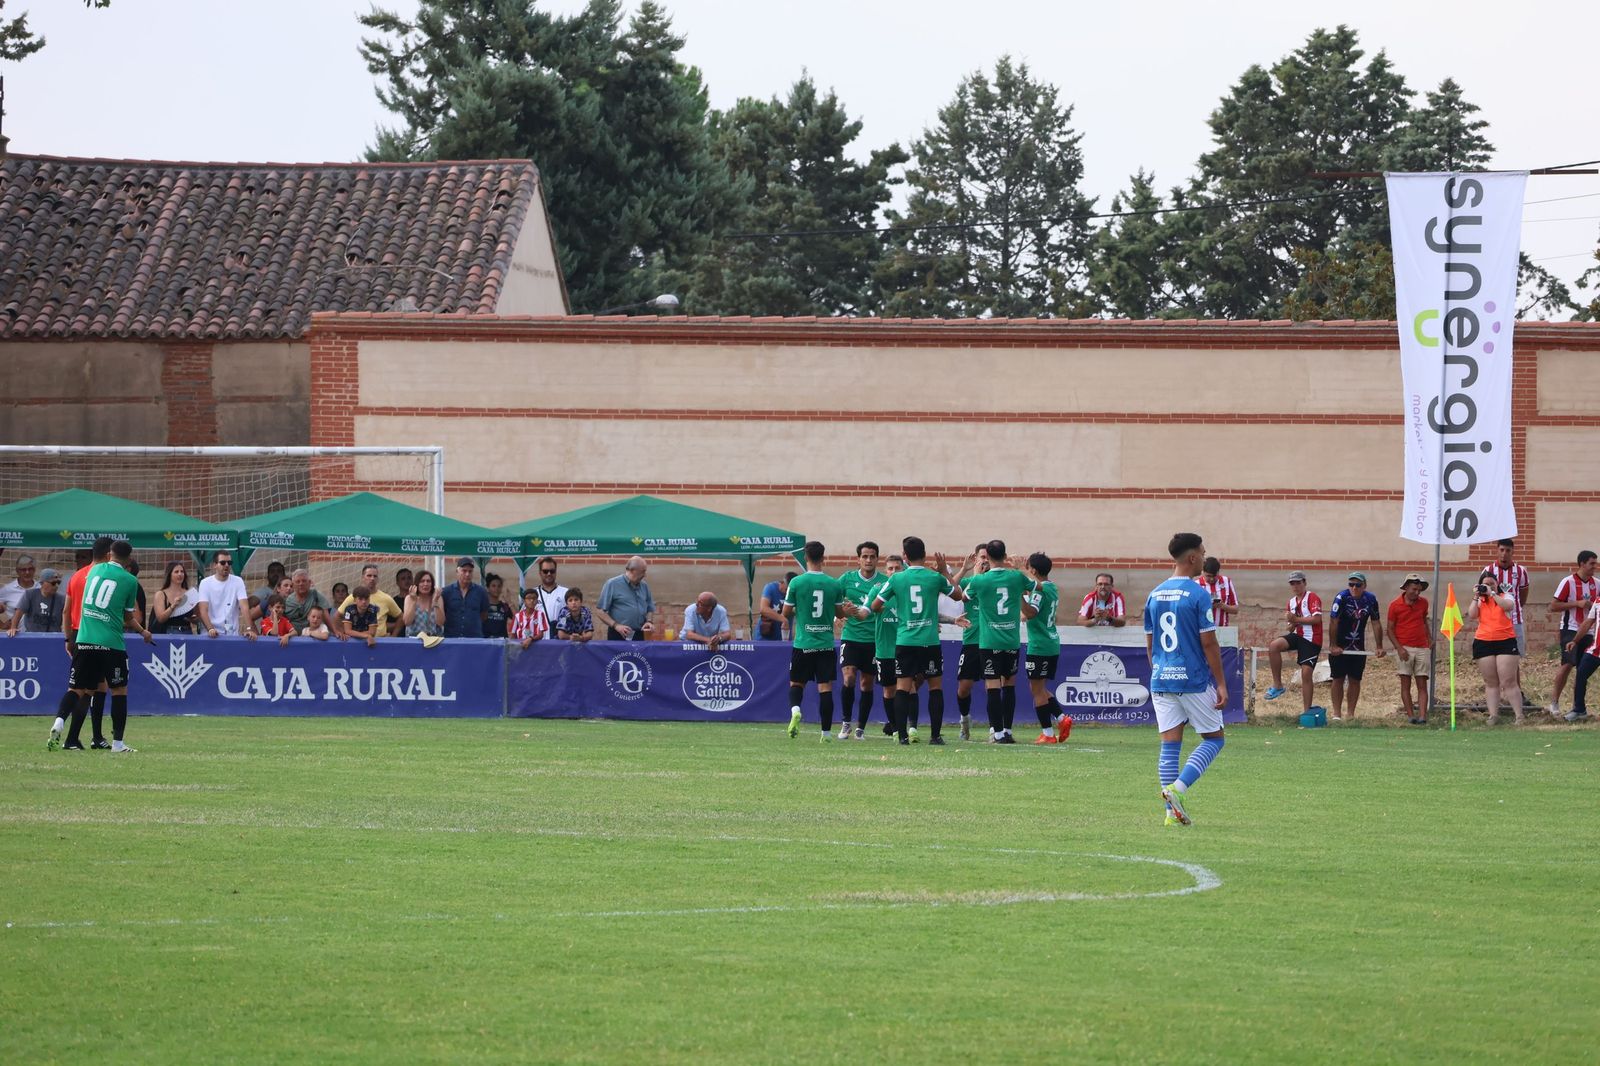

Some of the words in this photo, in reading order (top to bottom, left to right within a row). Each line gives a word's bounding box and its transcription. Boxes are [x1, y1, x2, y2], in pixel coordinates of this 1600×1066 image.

[1425, 177, 1492, 539] synergias
[1416, 482, 1428, 536] eventos
[644, 538, 666, 546] CAJA
[764, 536, 793, 544] RURAL
[85, 575, 117, 609] 10
[812, 590, 824, 618] 3
[910, 585, 923, 613] 5
[997, 587, 1009, 615] 2
[1160, 612, 1178, 653] 8
[11, 657, 39, 672] DE
[695, 672, 742, 685] Estrella
[218, 667, 315, 702] CAJA
[323, 668, 457, 700] RURAL
[696, 685, 739, 698] Galicia
[1066, 686, 1124, 705] Revilla
[1098, 709, 1122, 720] desde
[1126, 712, 1150, 721] 1929
